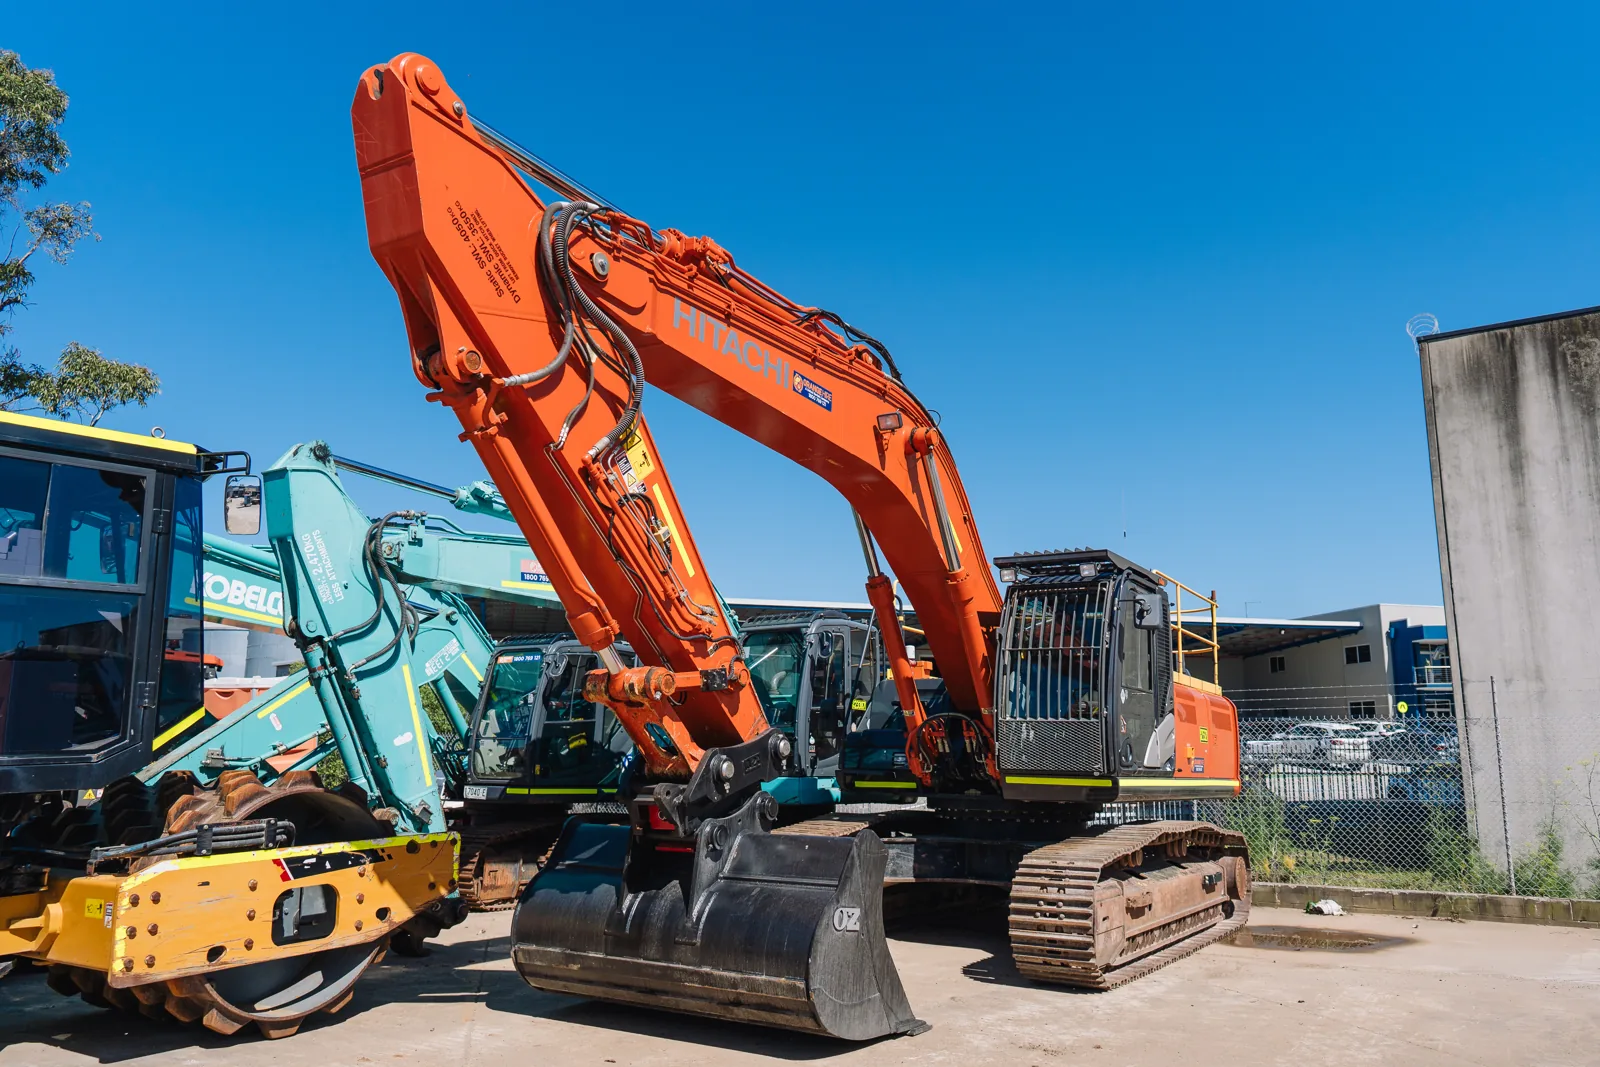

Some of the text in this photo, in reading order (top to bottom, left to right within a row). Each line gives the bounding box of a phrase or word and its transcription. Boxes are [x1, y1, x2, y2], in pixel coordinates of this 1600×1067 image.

[478, 226, 489, 241] HITCH
[486, 228, 496, 242] WHEN
[469, 243, 486, 269] SWL:
[477, 236, 494, 262] SWL:
[489, 242, 499, 258] QUICK
[495, 243, 507, 261] BUCKET
[498, 259, 508, 272] FROM
[506, 261, 519, 280] REMOVE
[486, 270, 504, 297] Static
[493, 263, 521, 304] Dynamic
[508, 273, 516, 284] LIFT
[673, 296, 790, 390] HITACHI
[312, 530, 344, 602] LESS ATTACHMENTS
[190, 572, 283, 616] KOBELC
[833, 907, 860, 932] OZ
